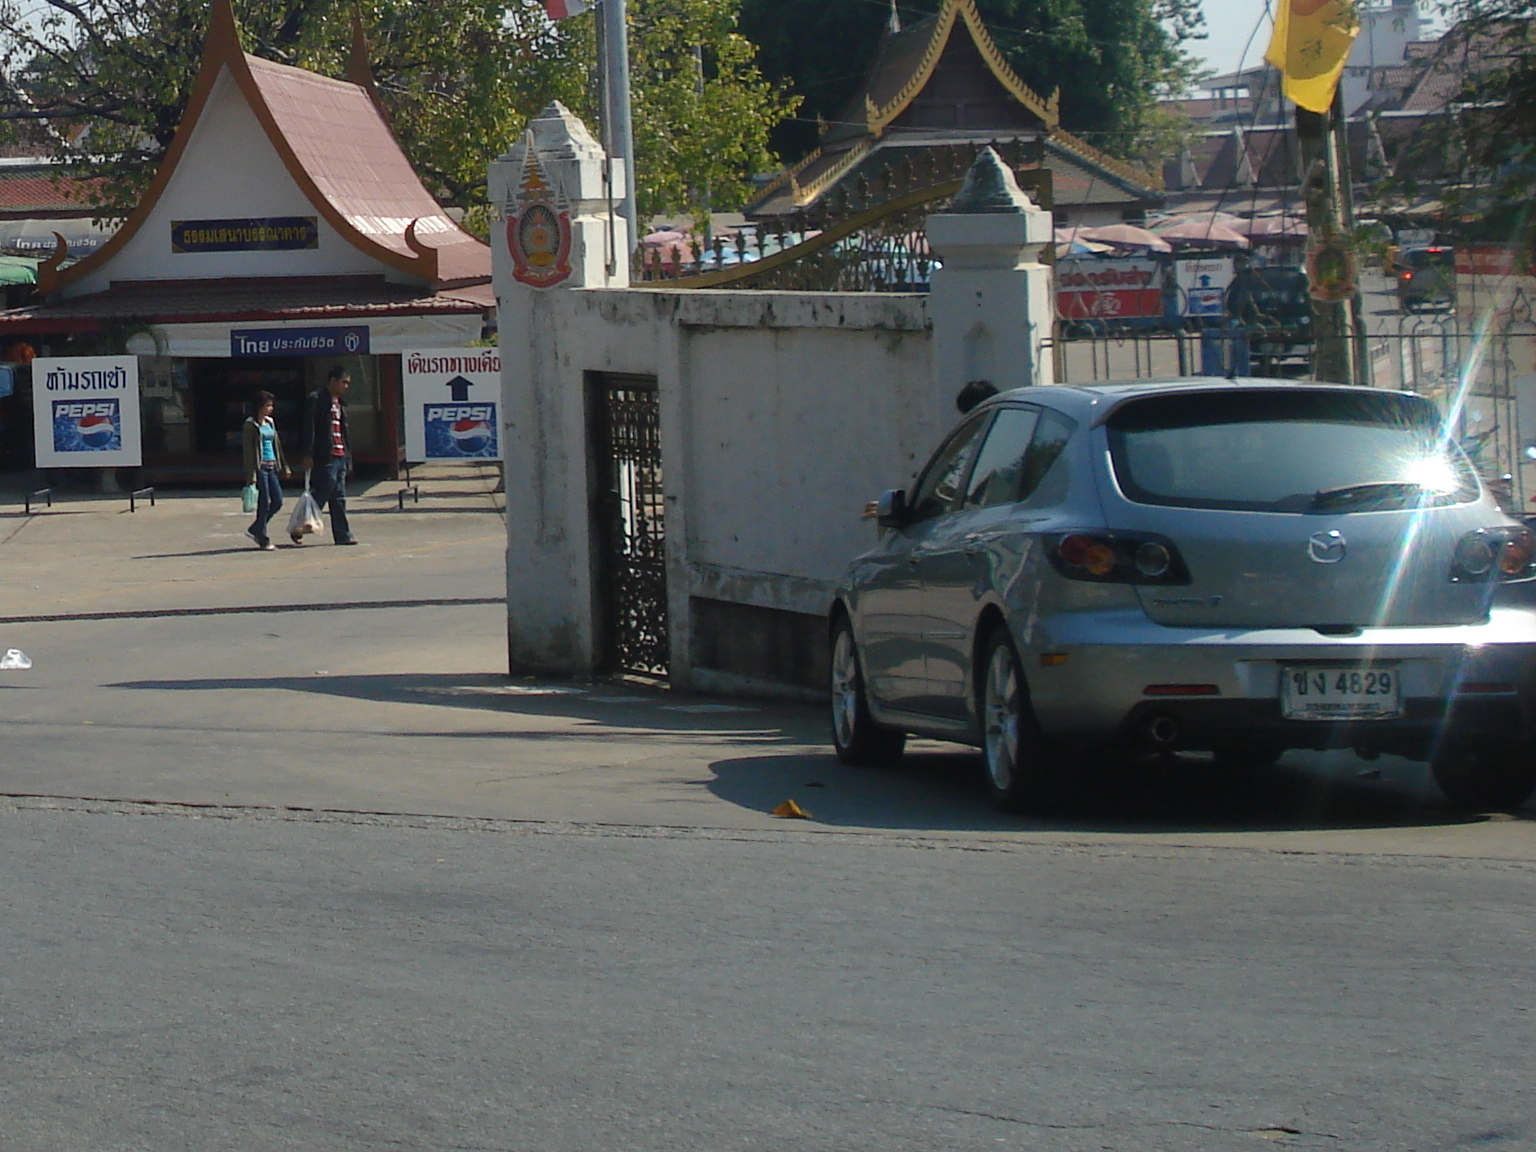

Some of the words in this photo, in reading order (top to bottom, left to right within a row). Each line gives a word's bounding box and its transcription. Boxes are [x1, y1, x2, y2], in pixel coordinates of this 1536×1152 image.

[234, 335, 270, 353] ไทย
[272, 337, 335, 350] ประกันชีวิต
[45, 365, 127, 391] ห้ามรถเข้า
[55, 403, 114, 418] PEPSI
[427, 406, 493, 422] PEPSI
[1335, 672, 1392, 695] 4829
